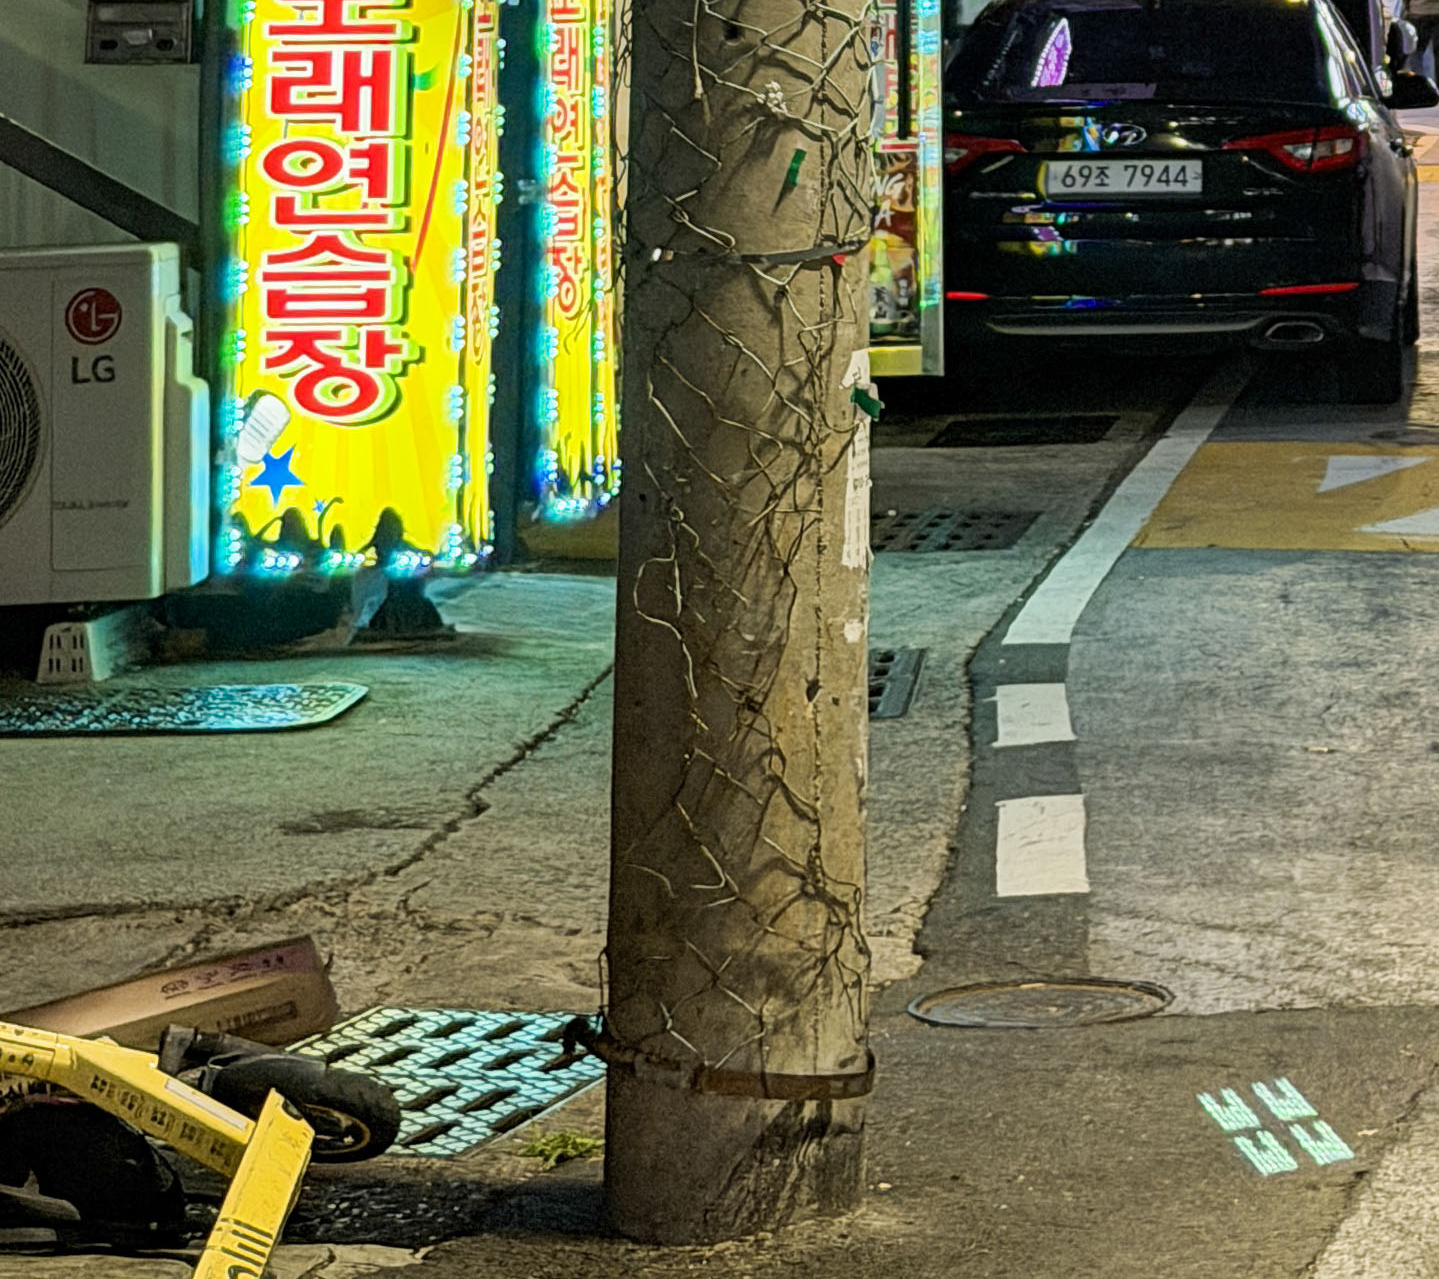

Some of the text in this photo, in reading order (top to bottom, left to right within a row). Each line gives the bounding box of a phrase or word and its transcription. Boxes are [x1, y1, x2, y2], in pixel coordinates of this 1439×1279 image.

[1060, 163, 1189, 189] 69조 7944
[70, 355, 117, 385] LG
